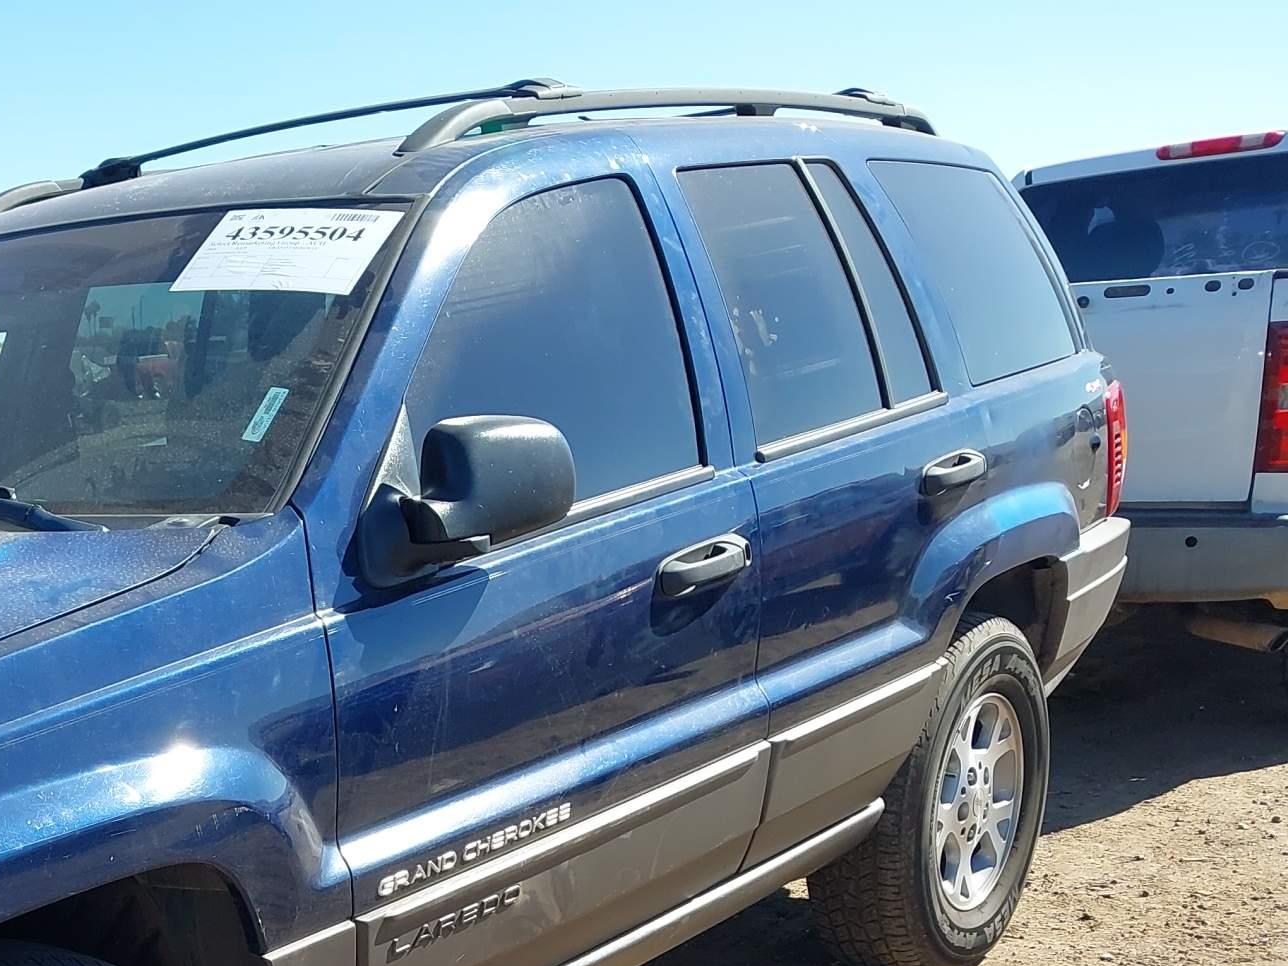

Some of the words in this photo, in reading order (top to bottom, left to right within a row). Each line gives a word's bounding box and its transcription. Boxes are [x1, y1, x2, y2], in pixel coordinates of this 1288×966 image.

[225, 226, 366, 242] 43595504
[378, 850, 458, 897] GRAND
[462, 802, 572, 862] CHEROKEE
[386, 884, 522, 963] LAREDO
